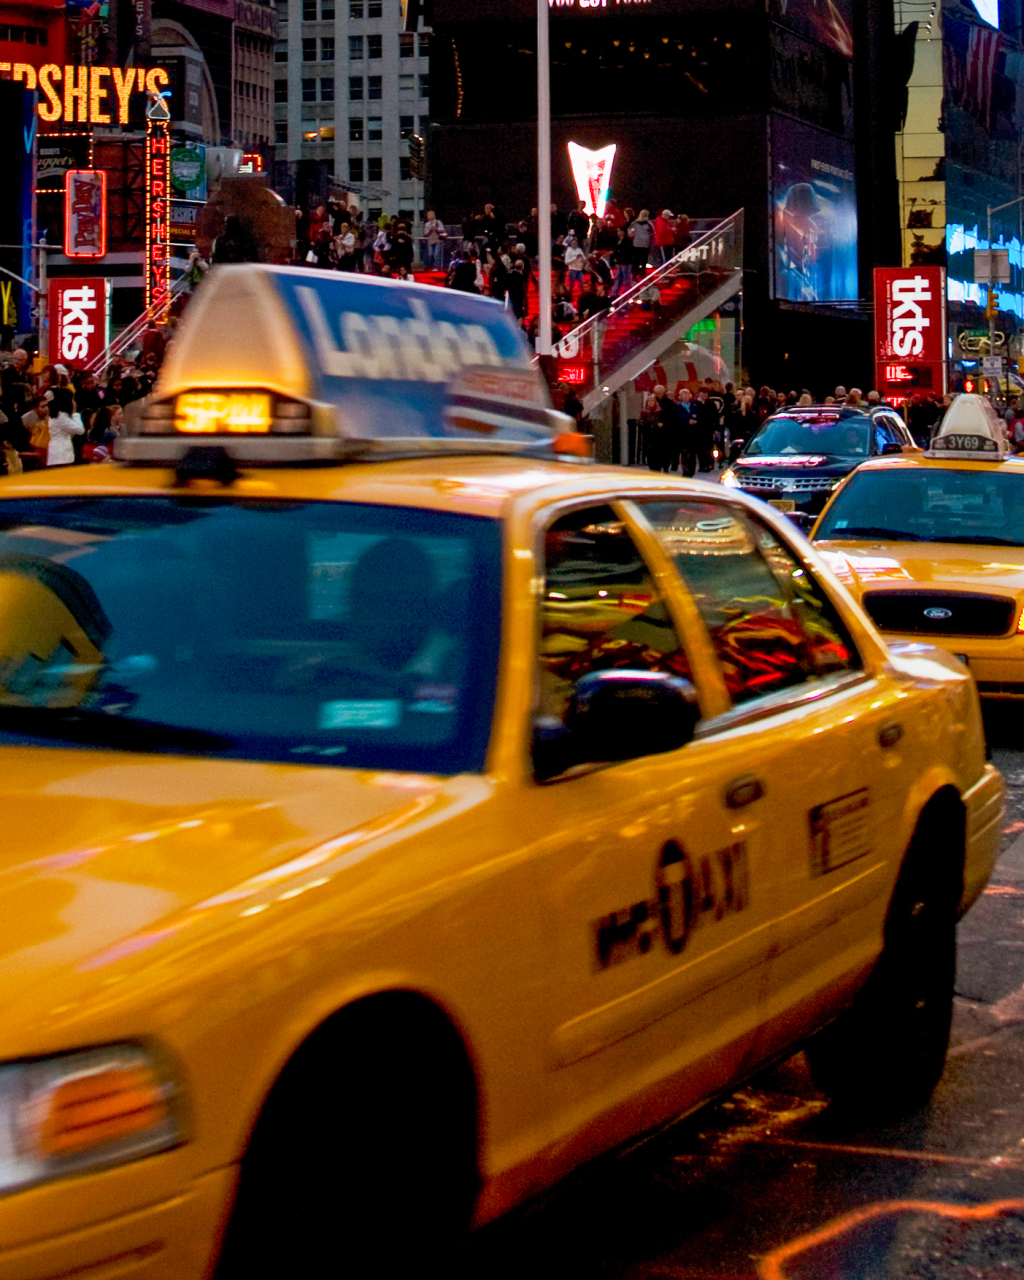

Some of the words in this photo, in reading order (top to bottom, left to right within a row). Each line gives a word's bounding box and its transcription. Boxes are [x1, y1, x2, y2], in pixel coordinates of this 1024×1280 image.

[61, 285, 97, 361] tkts
[891, 275, 932, 357] tkts
[948, 436, 979, 449] 3Y69
